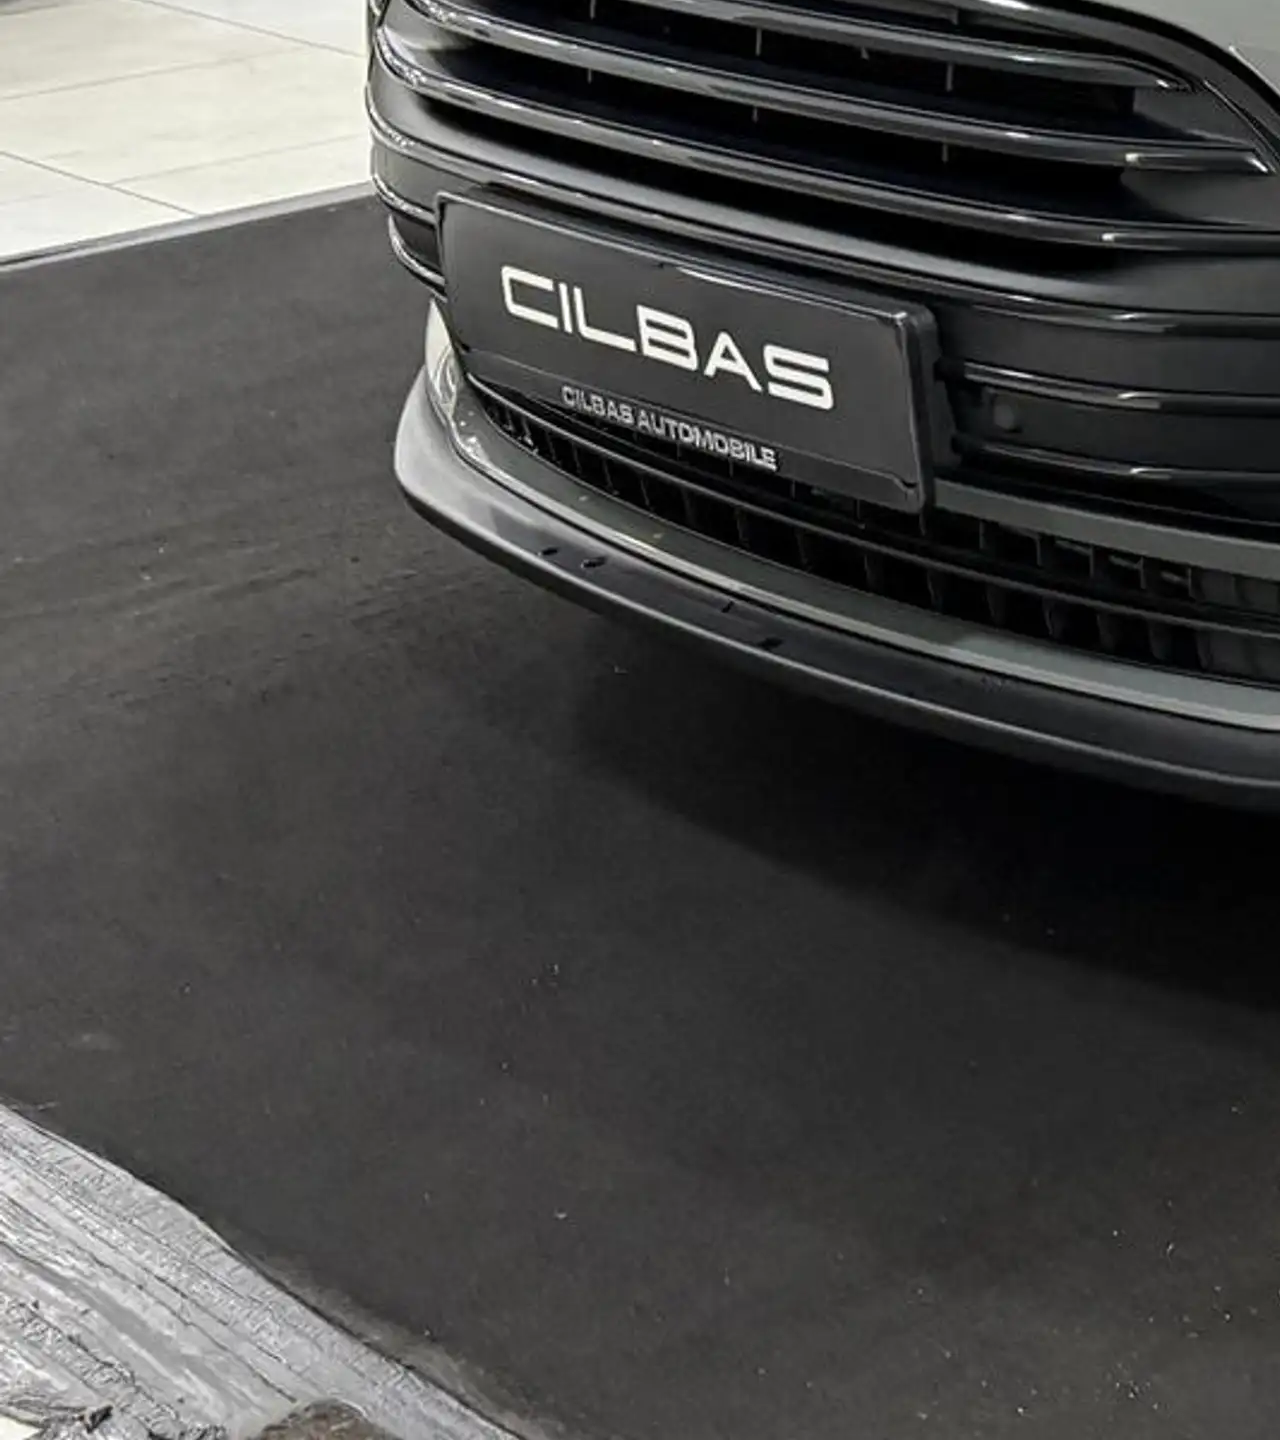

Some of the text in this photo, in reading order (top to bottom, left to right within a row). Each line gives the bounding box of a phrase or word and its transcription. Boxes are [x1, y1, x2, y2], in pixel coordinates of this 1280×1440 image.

[501, 265, 834, 410] CILBAS
[561, 385, 778, 472] CILBAS AUTOMOBILE
